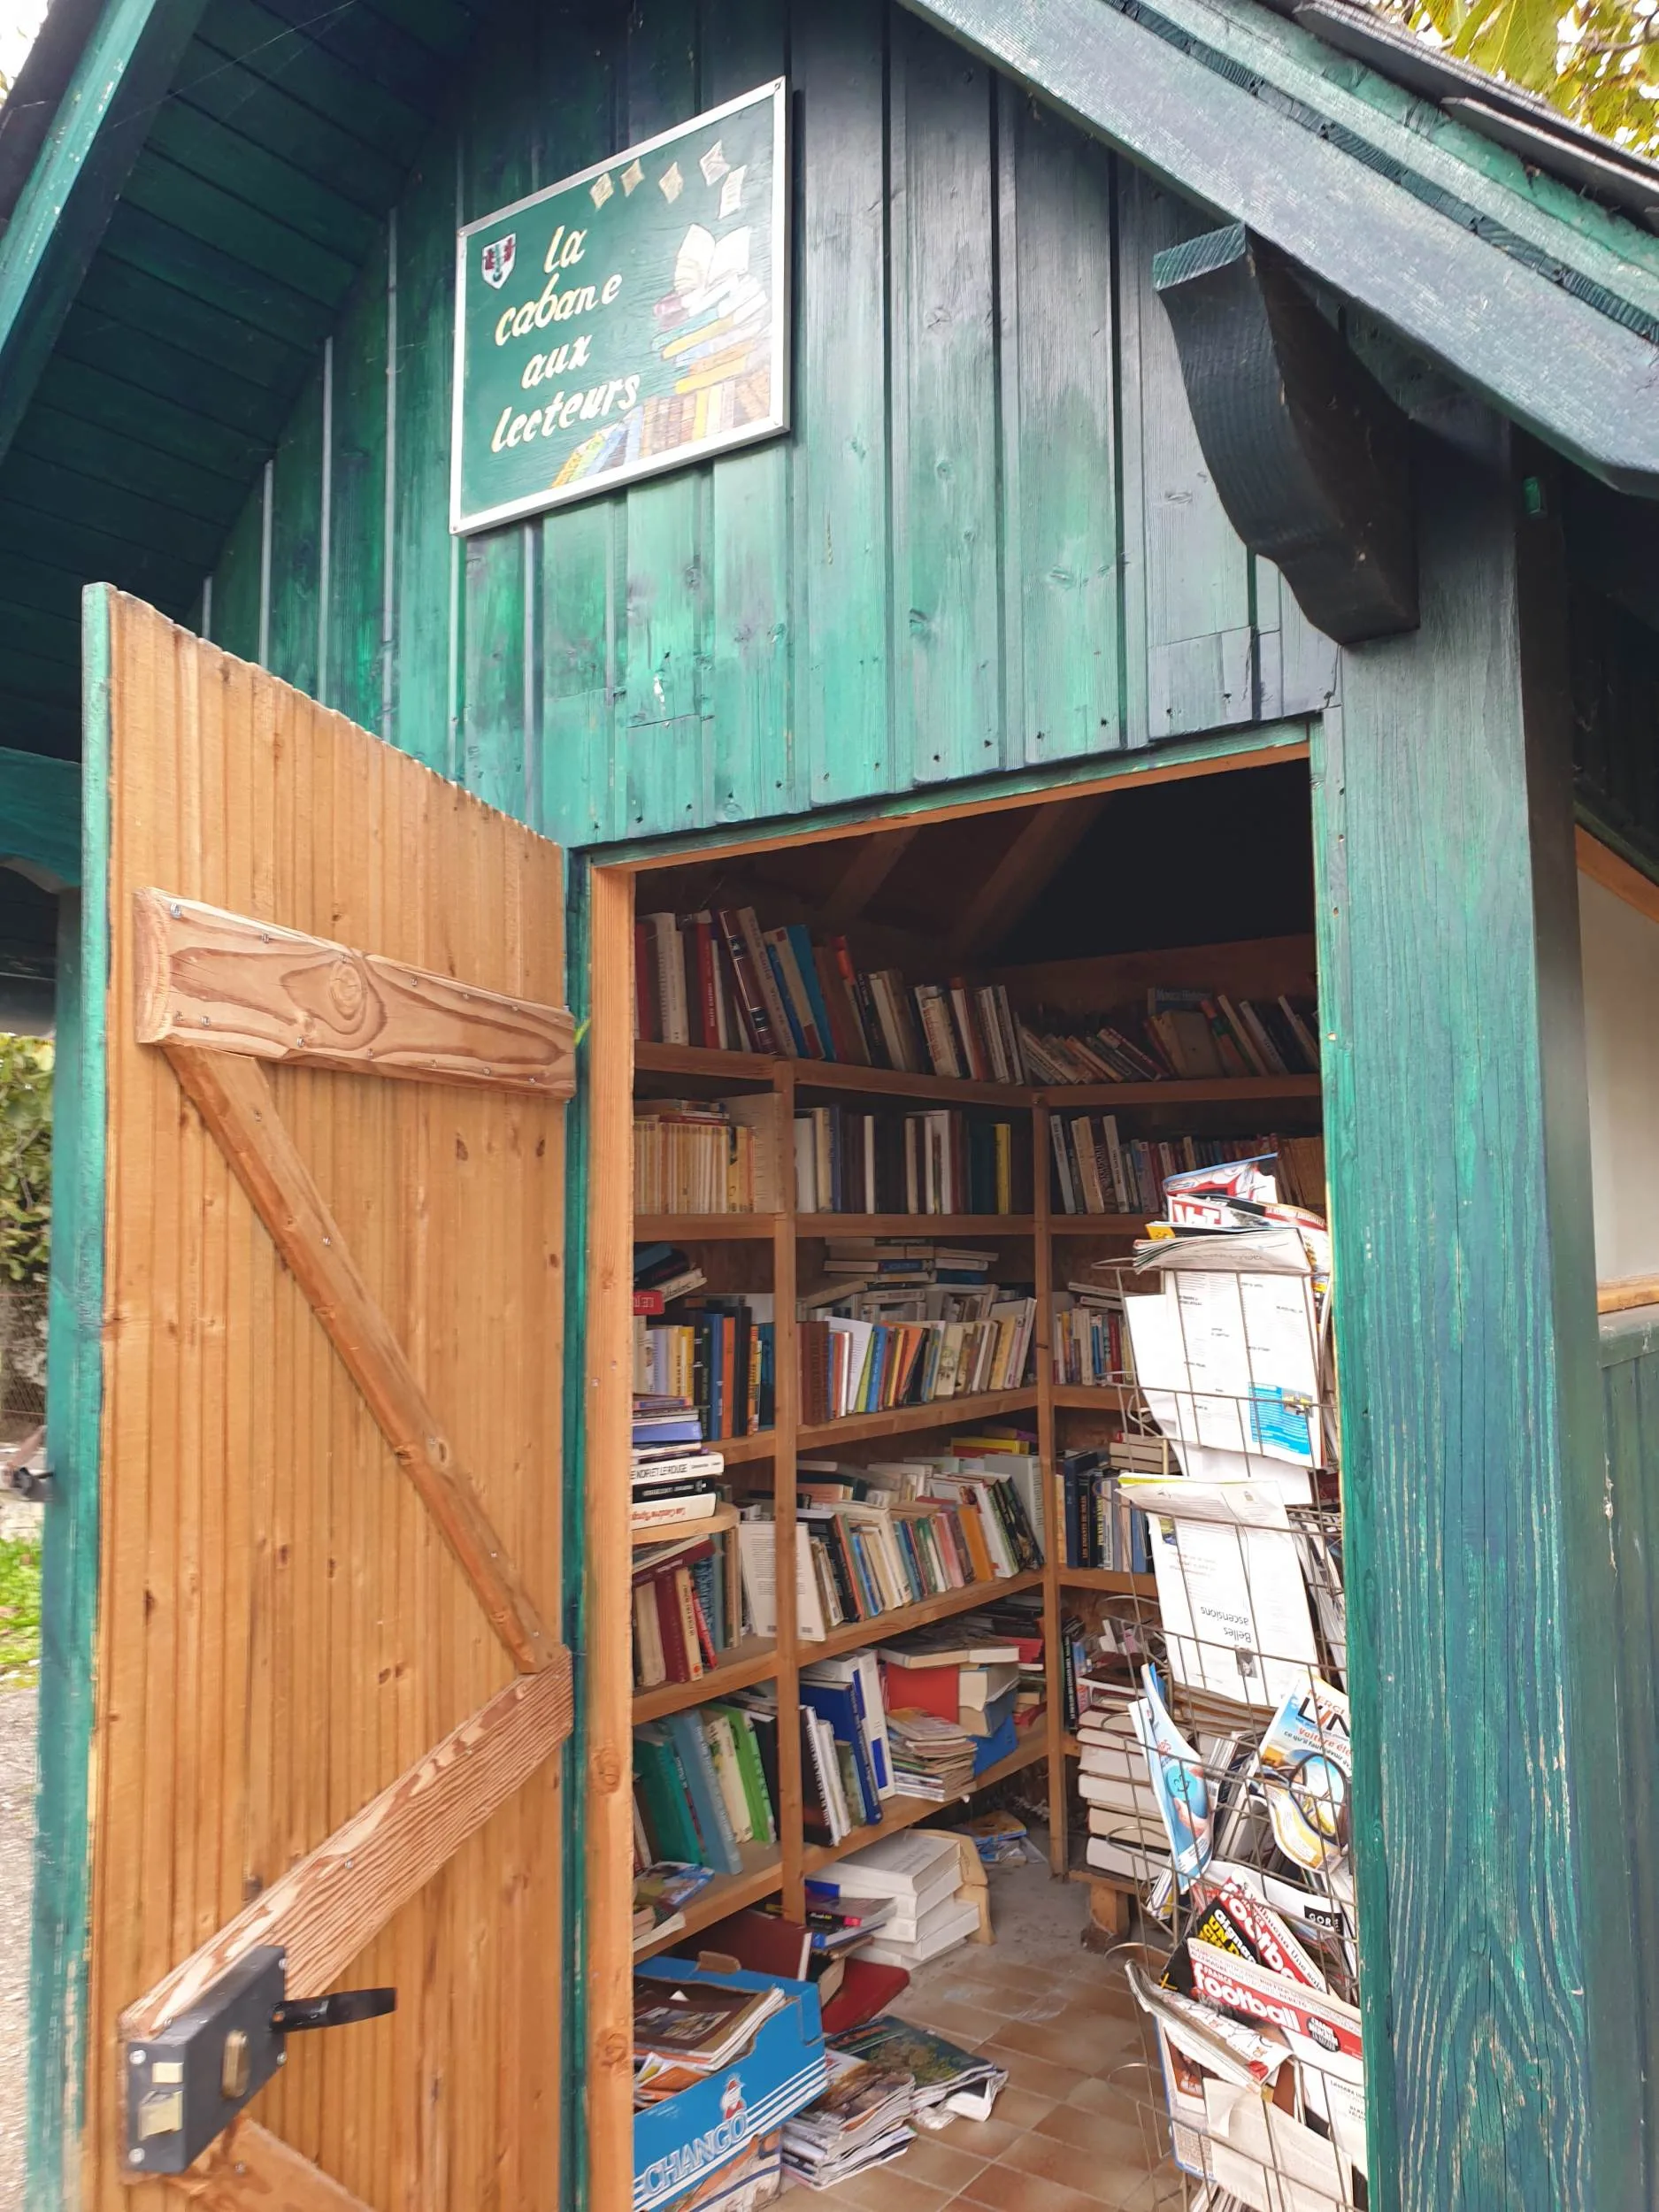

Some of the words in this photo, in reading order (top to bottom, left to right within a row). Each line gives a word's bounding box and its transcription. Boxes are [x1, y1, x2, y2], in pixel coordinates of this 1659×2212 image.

[495, 273, 623, 346] cabane
[521, 334, 593, 389] aux
[491, 373, 641, 453] lecteurs
[1201, 1606, 1249, 1626] ascensions
[1223, 1626, 1252, 1643] Belles
[1194, 1962, 1301, 2033] football
[1204, 1967, 1233, 1988] FRANCE
[644, 2110, 748, 2194] CHANGO
